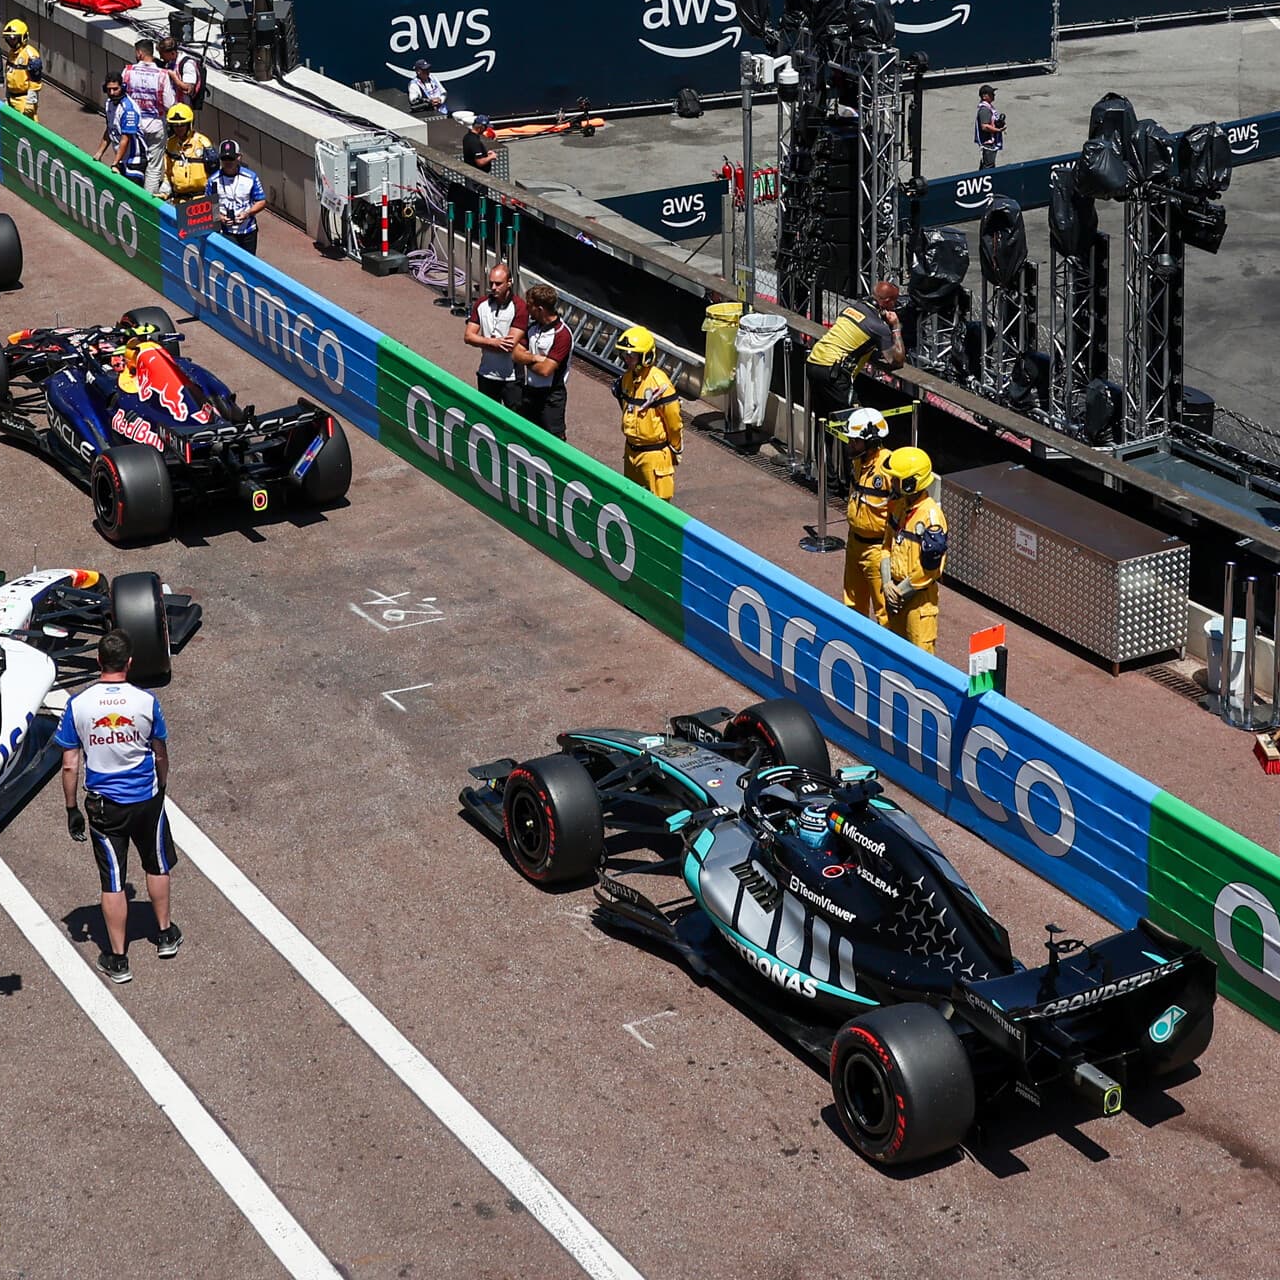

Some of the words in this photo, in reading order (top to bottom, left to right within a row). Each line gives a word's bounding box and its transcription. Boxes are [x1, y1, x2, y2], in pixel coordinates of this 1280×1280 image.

[389, 7, 491, 53] aws
[1227, 123, 1259, 144] aws
[16, 136, 138, 259] aramco
[661, 193, 706, 221] aws
[955, 176, 993, 200] aws
[183, 242, 346, 396] aramco
[111, 409, 137, 439] Red
[134, 417, 165, 453] Bull
[189, 410, 318, 445] ORACLE
[405, 384, 636, 583] aramco
[99, 698, 127, 706] HUGO
[725, 584, 1077, 859] aramco
[89, 730, 114, 746] Red
[115, 729, 140, 744] Bull
[842, 821, 887, 858] Microsoft
[799, 881, 857, 923] TeamViewer
[861, 869, 893, 898] SOLERA
[1042, 960, 1184, 1018] CROWDSTRIKE
[968, 993, 1022, 1041] CROWDSTRIKE
